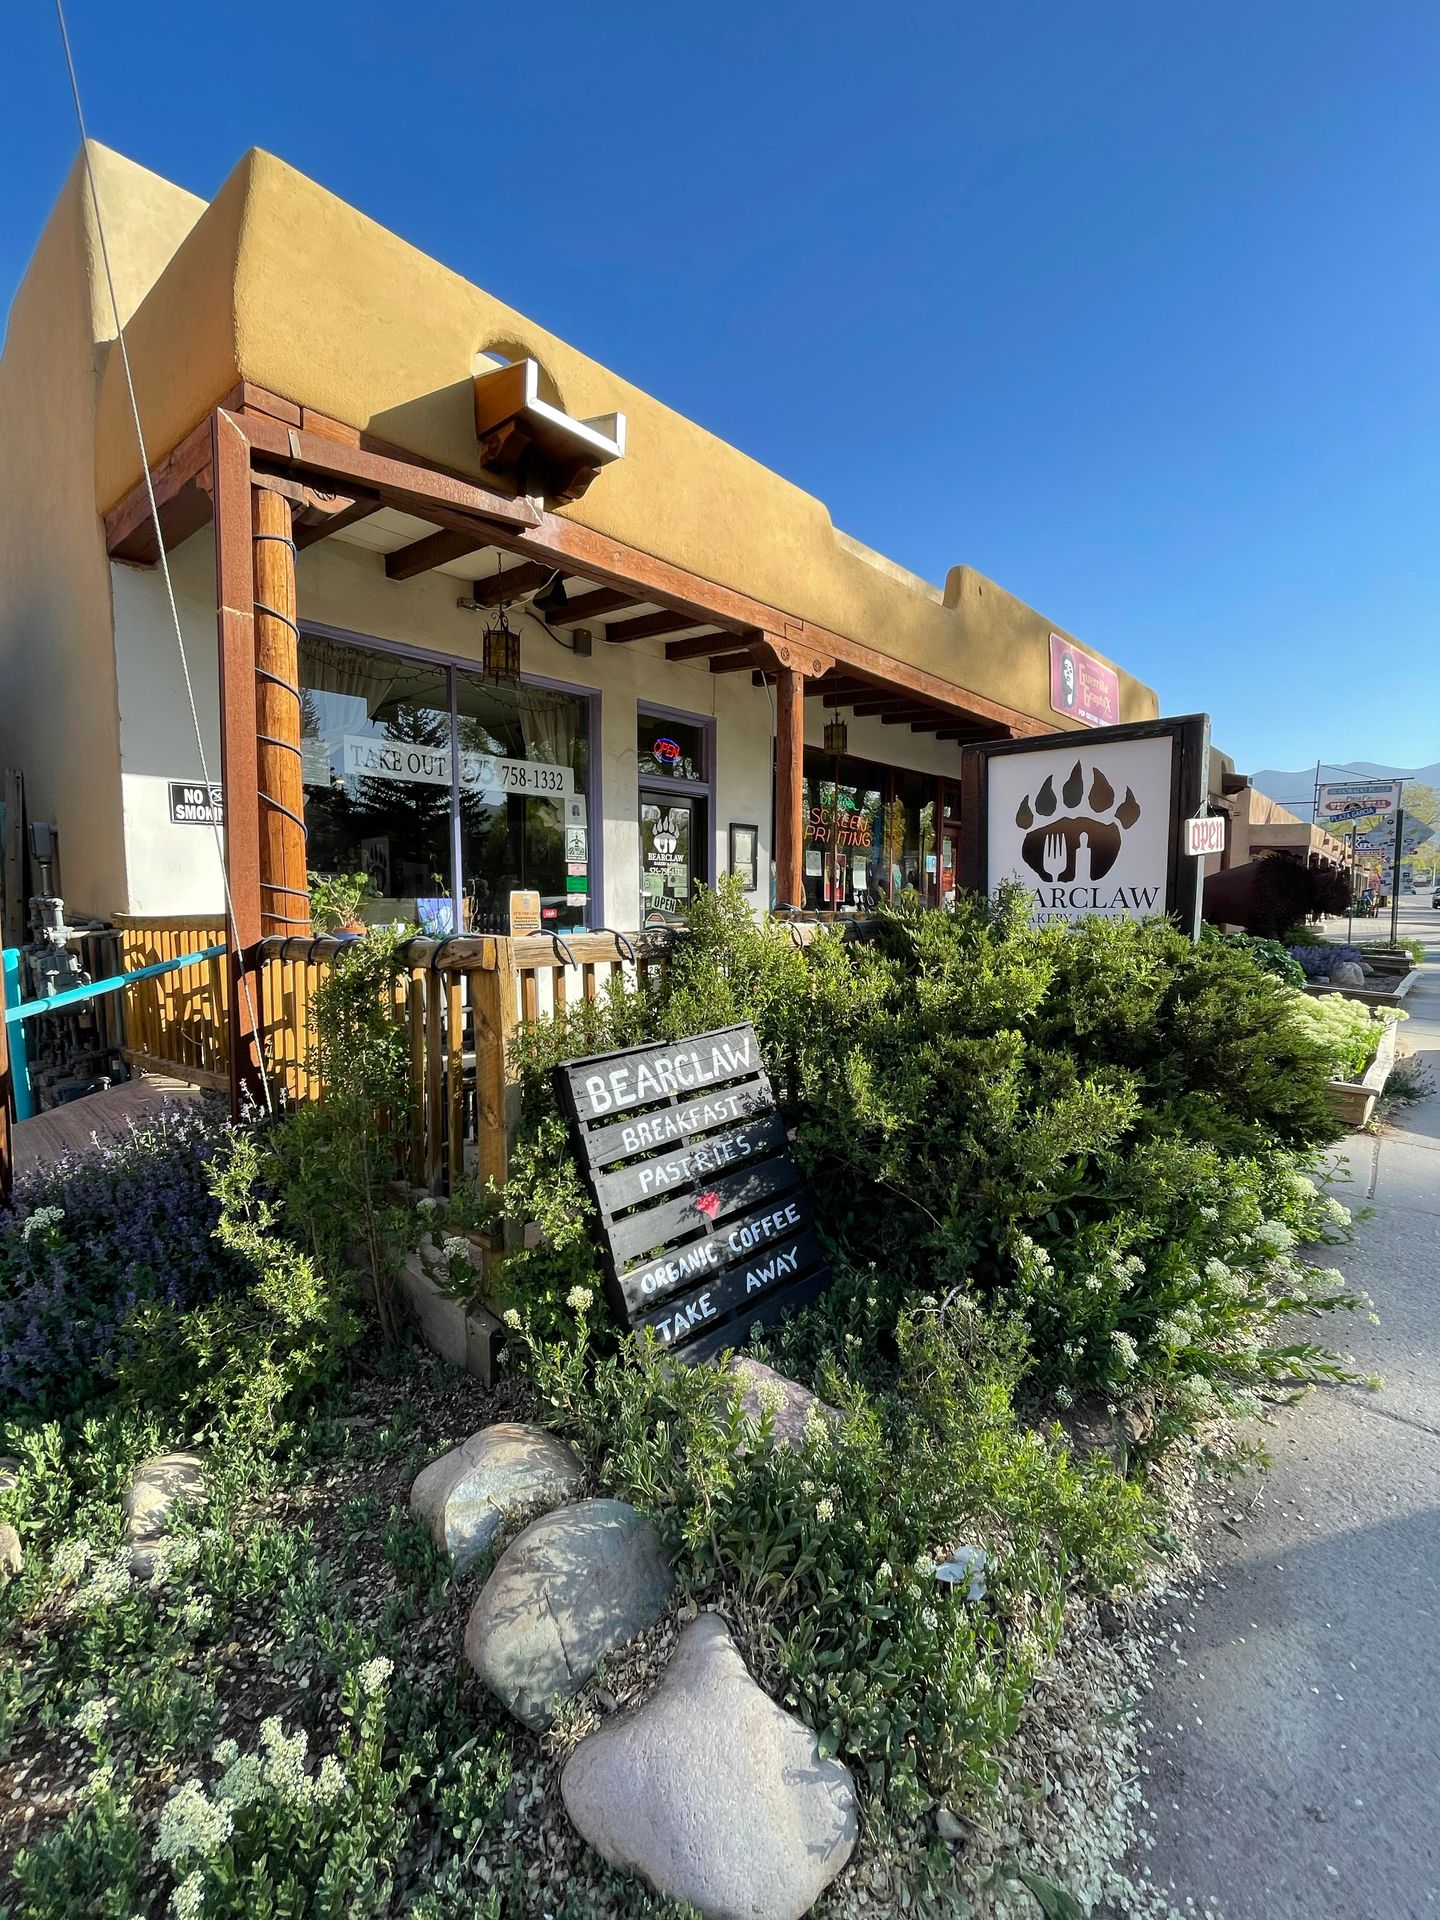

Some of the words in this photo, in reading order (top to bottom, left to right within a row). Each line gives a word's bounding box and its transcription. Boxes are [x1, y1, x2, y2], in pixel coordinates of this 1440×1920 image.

[350, 744, 402, 771] TAKE
[407, 753, 446, 777] OUT
[502, 765, 564, 791] 758-1332
[183, 788, 204, 805] NO
[810, 808, 869, 832] SCREEN
[1331, 812, 1351, 821] PLAZA
[1351, 807, 1375, 818] GARCIA
[1192, 821, 1223, 852] open
[647, 852, 685, 862] BEARCLAW
[654, 895, 676, 912] OPEN
[992, 886, 1161, 909] ARCLAW
[585, 1037, 751, 1114] BEARCLAW
[621, 1095, 739, 1153] BREAKFAST
[639, 1135, 752, 1194] PASTRIES
[641, 1242, 718, 1294] ORGANIC
[728, 1203, 801, 1253] COFFEE
[656, 1293, 717, 1341] TAKE
[745, 1246, 799, 1294] AWAY
